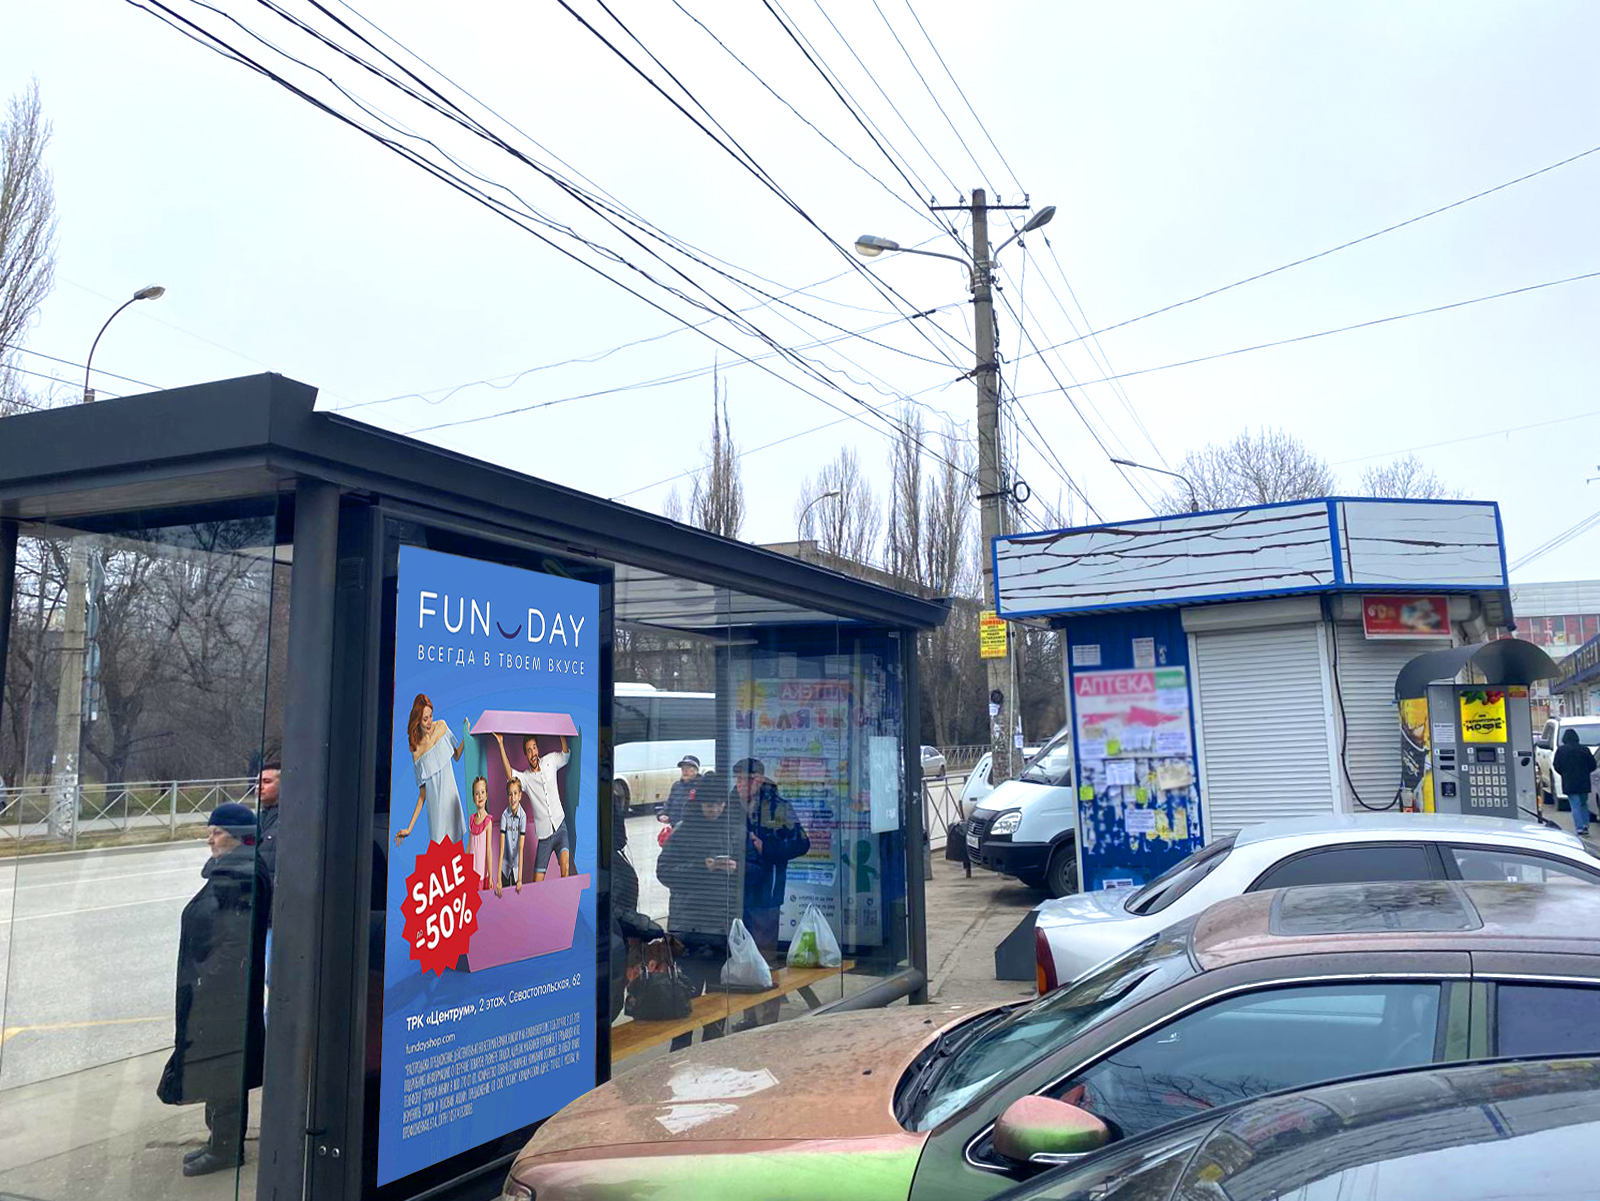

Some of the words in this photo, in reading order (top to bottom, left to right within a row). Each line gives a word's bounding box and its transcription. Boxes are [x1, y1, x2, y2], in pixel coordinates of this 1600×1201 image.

[419, 590, 491, 637] FUN
[527, 608, 585, 648] DAY
[417, 644, 476, 668] ВСЕГДА
[484, 650, 491, 666] В
[499, 652, 541, 671] ТВОЕМ
[548, 658, 585, 675] ВКУСЕ
[1079, 675, 1153, 695] АПТЕКА
[412, 854, 465, 915] SALE
[416, 892, 472, 950] -50%
[406, 1013, 424, 1031] ТРК
[426, 1003, 477, 1026] «Центрум»,
[479, 997, 485, 1012] 2
[486, 994, 508, 1011] этаж,
[508, 977, 571, 1004] Севастопольская,
[572, 972, 581, 987] 62
[406, 1032, 456, 1055] fundayshop.com
